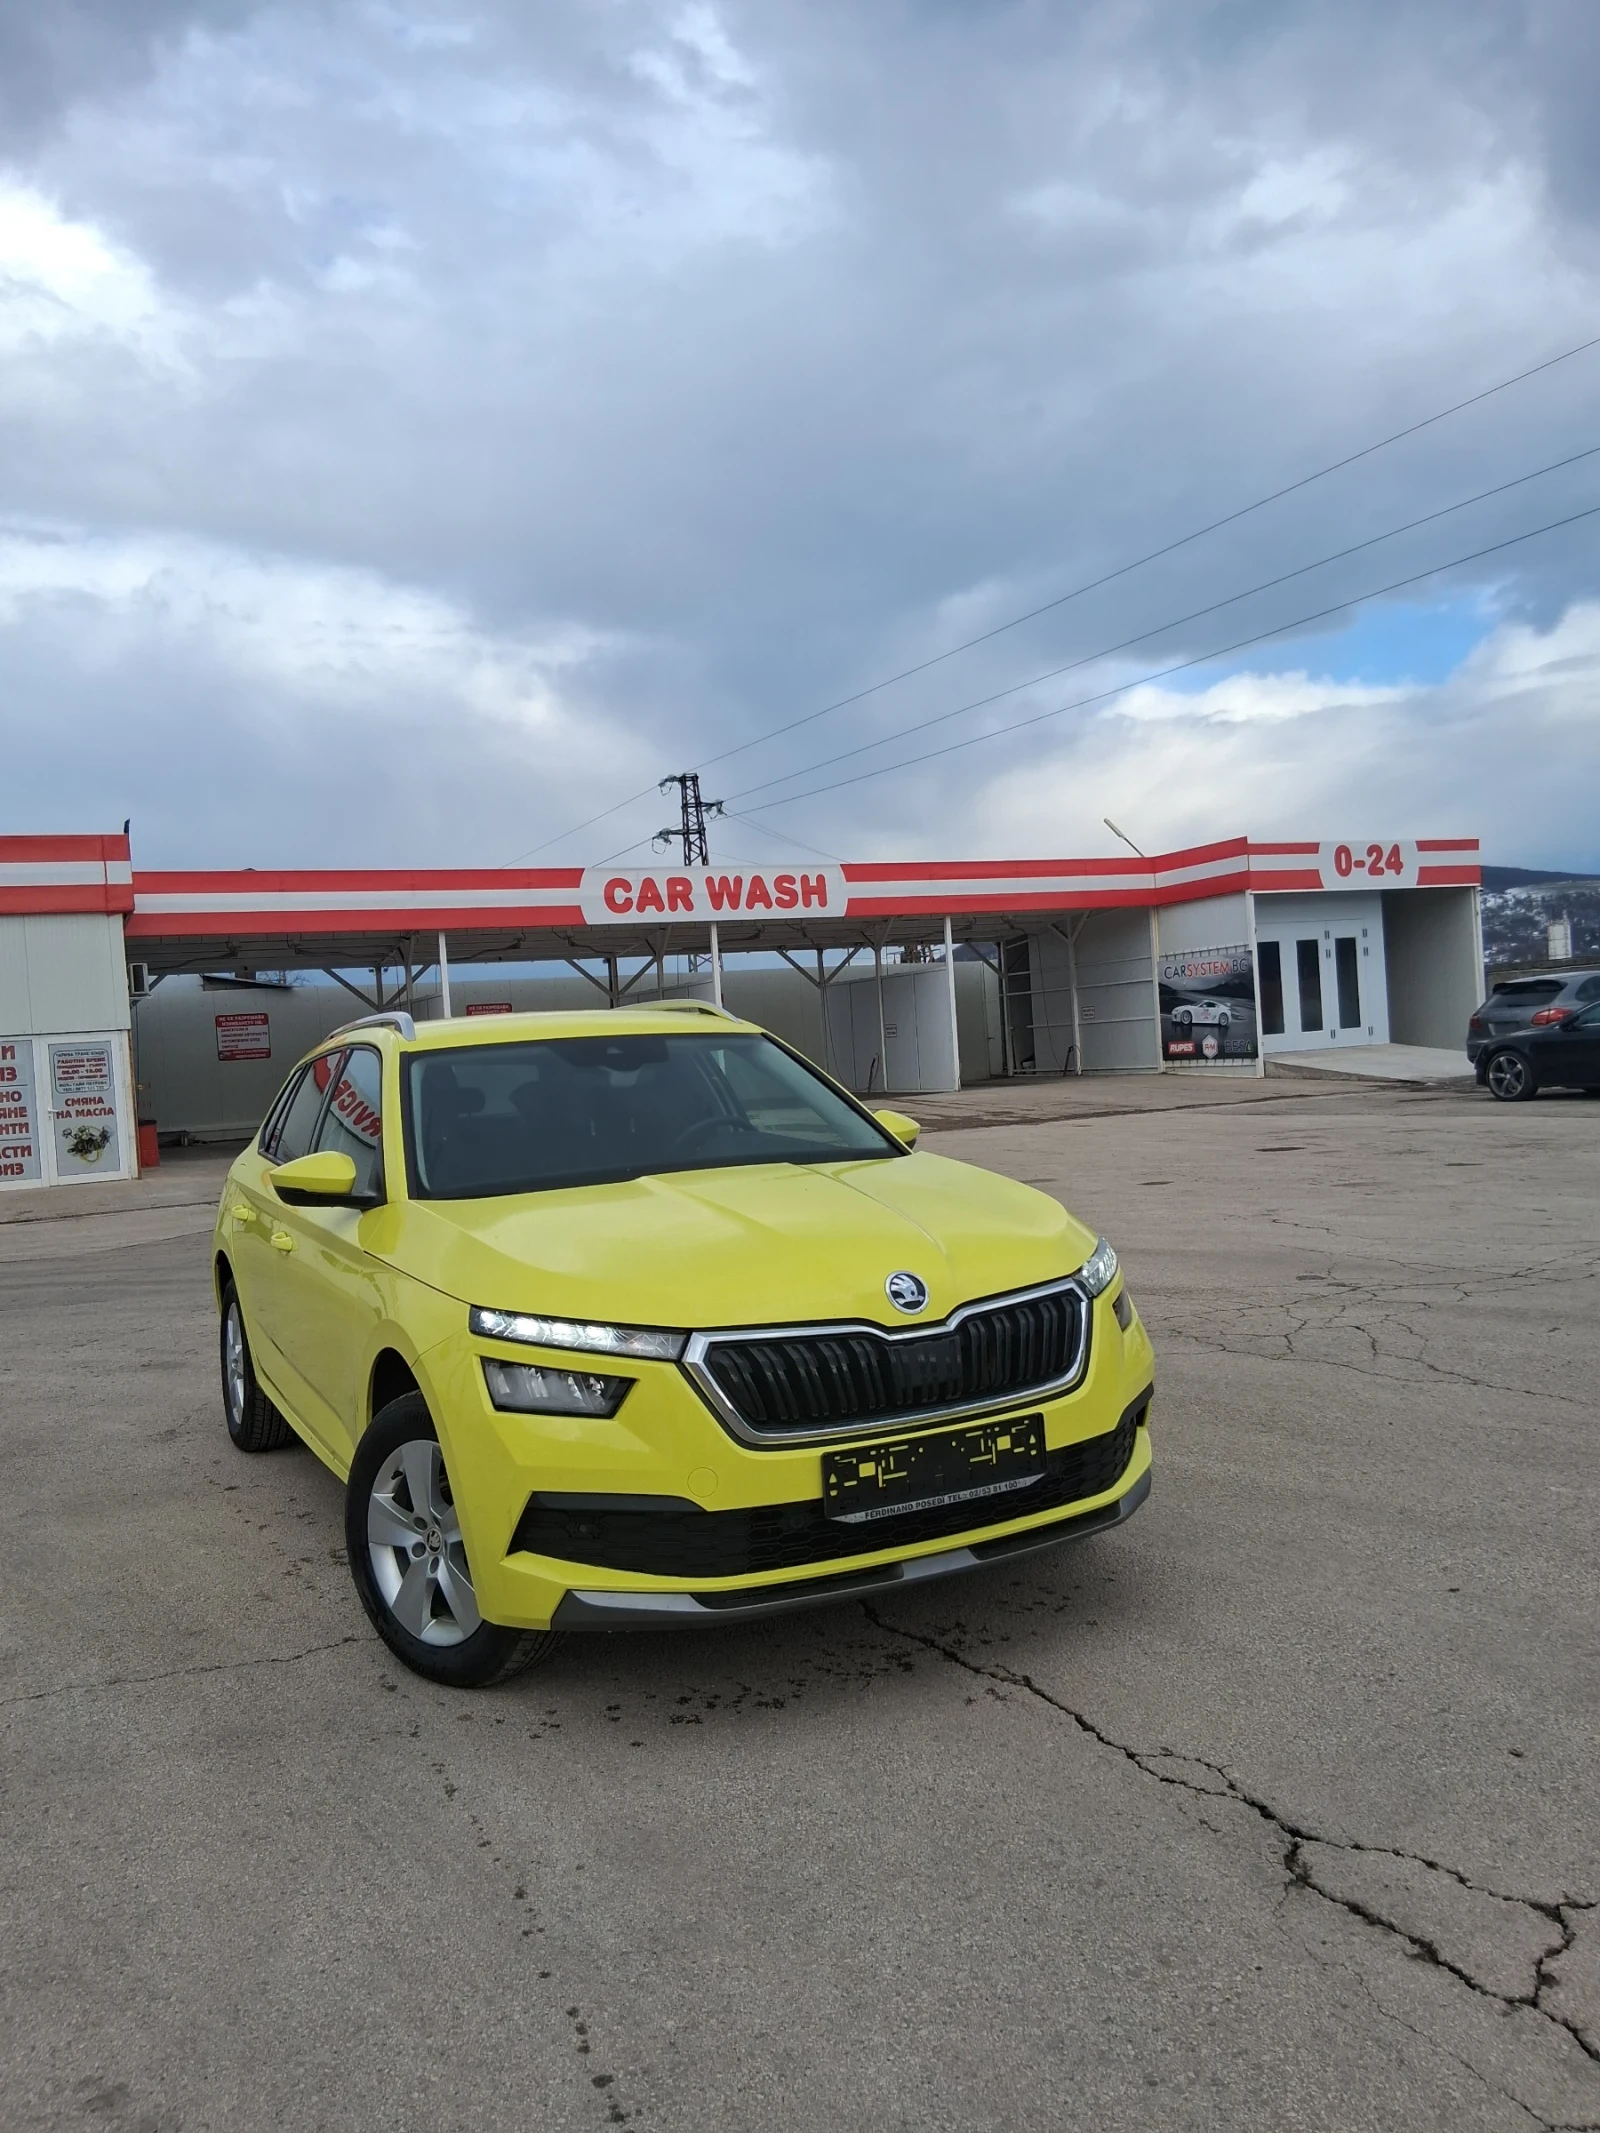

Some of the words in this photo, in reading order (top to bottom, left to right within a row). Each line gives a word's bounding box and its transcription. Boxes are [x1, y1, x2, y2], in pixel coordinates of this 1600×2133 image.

[1334, 844, 1403, 877] 0-24
[604, 876, 694, 914] CAR
[706, 874, 828, 910] WASH
[1170, 1043, 1193, 1052] RUPES
[0, 1091, 22, 1103] НО
[65, 1096, 104, 1107] СМЯНА
[0, 1107, 27, 1119] ЯНЕ
[56, 1110, 72, 1119] НА
[75, 1107, 114, 1117] МАСЛА
[0, 1145, 32, 1159] СТИ
[865, 1503, 913, 1519] FERDINAND
